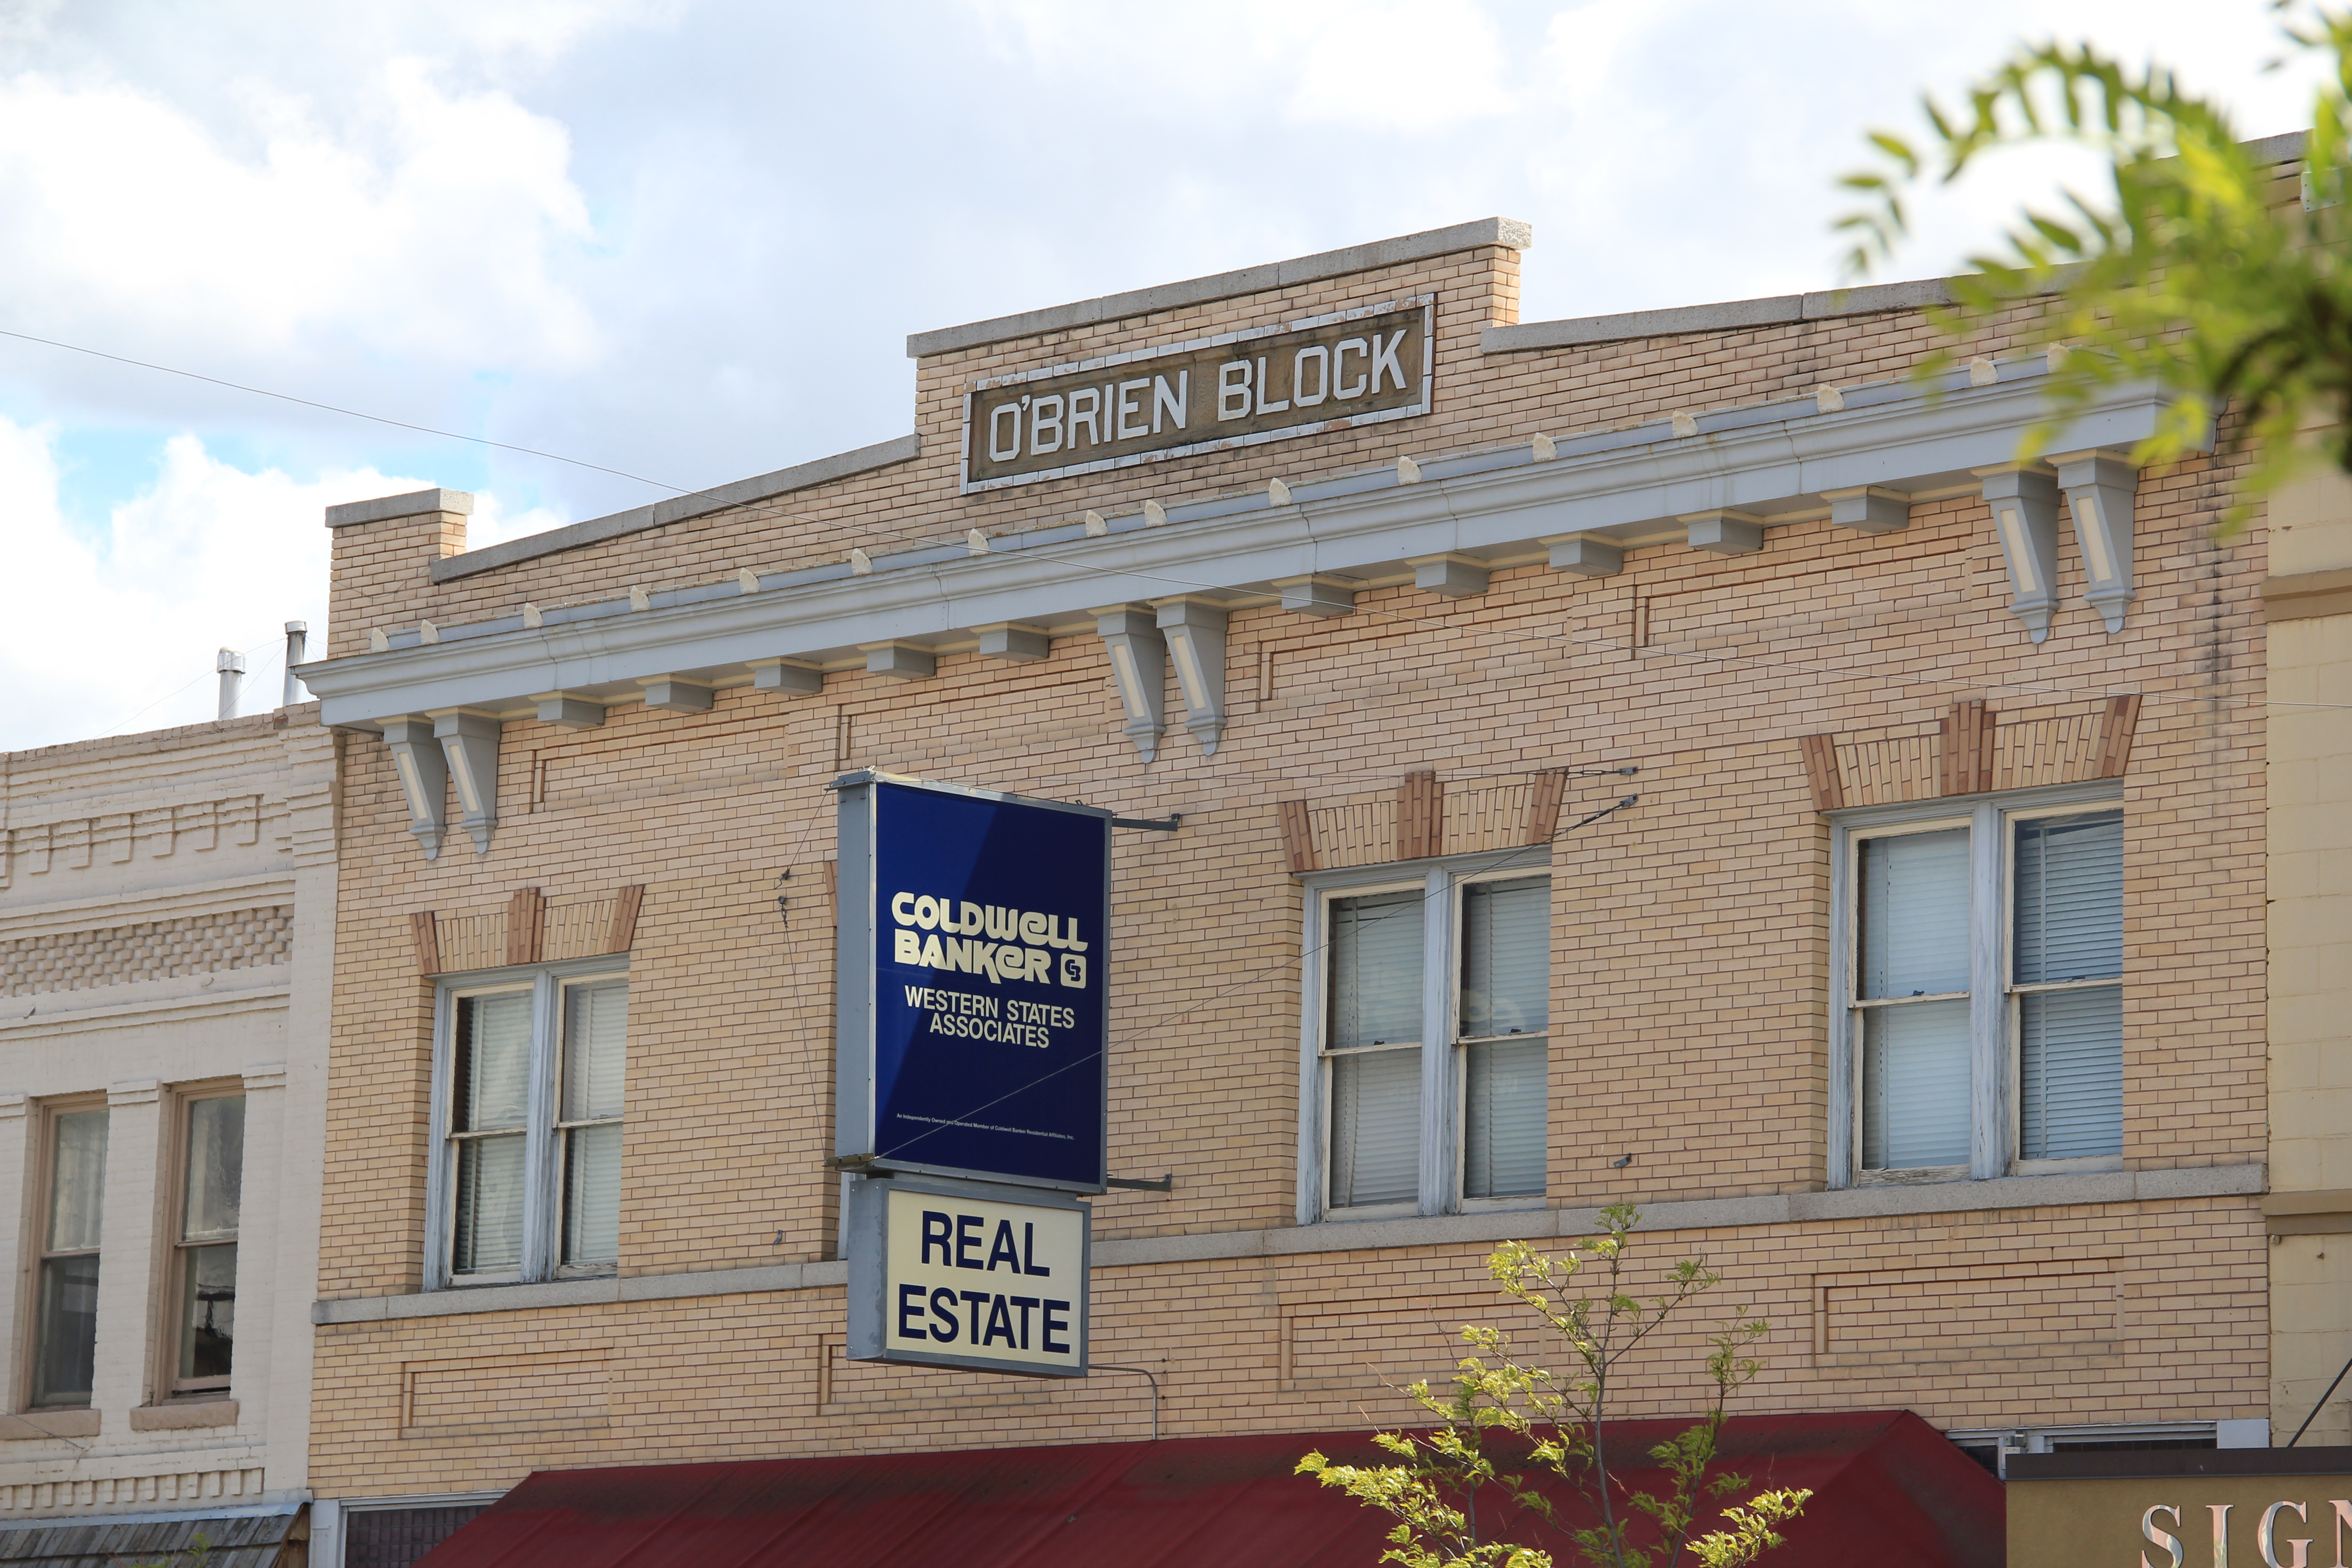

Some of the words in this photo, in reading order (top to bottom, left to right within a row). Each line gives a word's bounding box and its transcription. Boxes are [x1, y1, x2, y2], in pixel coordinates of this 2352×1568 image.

[988, 369, 1187, 463] O'BRIEN
[1218, 329, 1407, 422] BLOCK
[892, 892, 1088, 951] COLDWELL
[895, 928, 1051, 984] BANKER
[905, 985, 998, 1019] WESTERN
[1007, 1000, 1075, 1029] STATES
[930, 1013, 1049, 1049] ASSOCIATES
[903, 1114, 931, 1123] Independently
[921, 1210, 1050, 1277] REAL
[899, 1284, 1070, 1354] ESTATE
